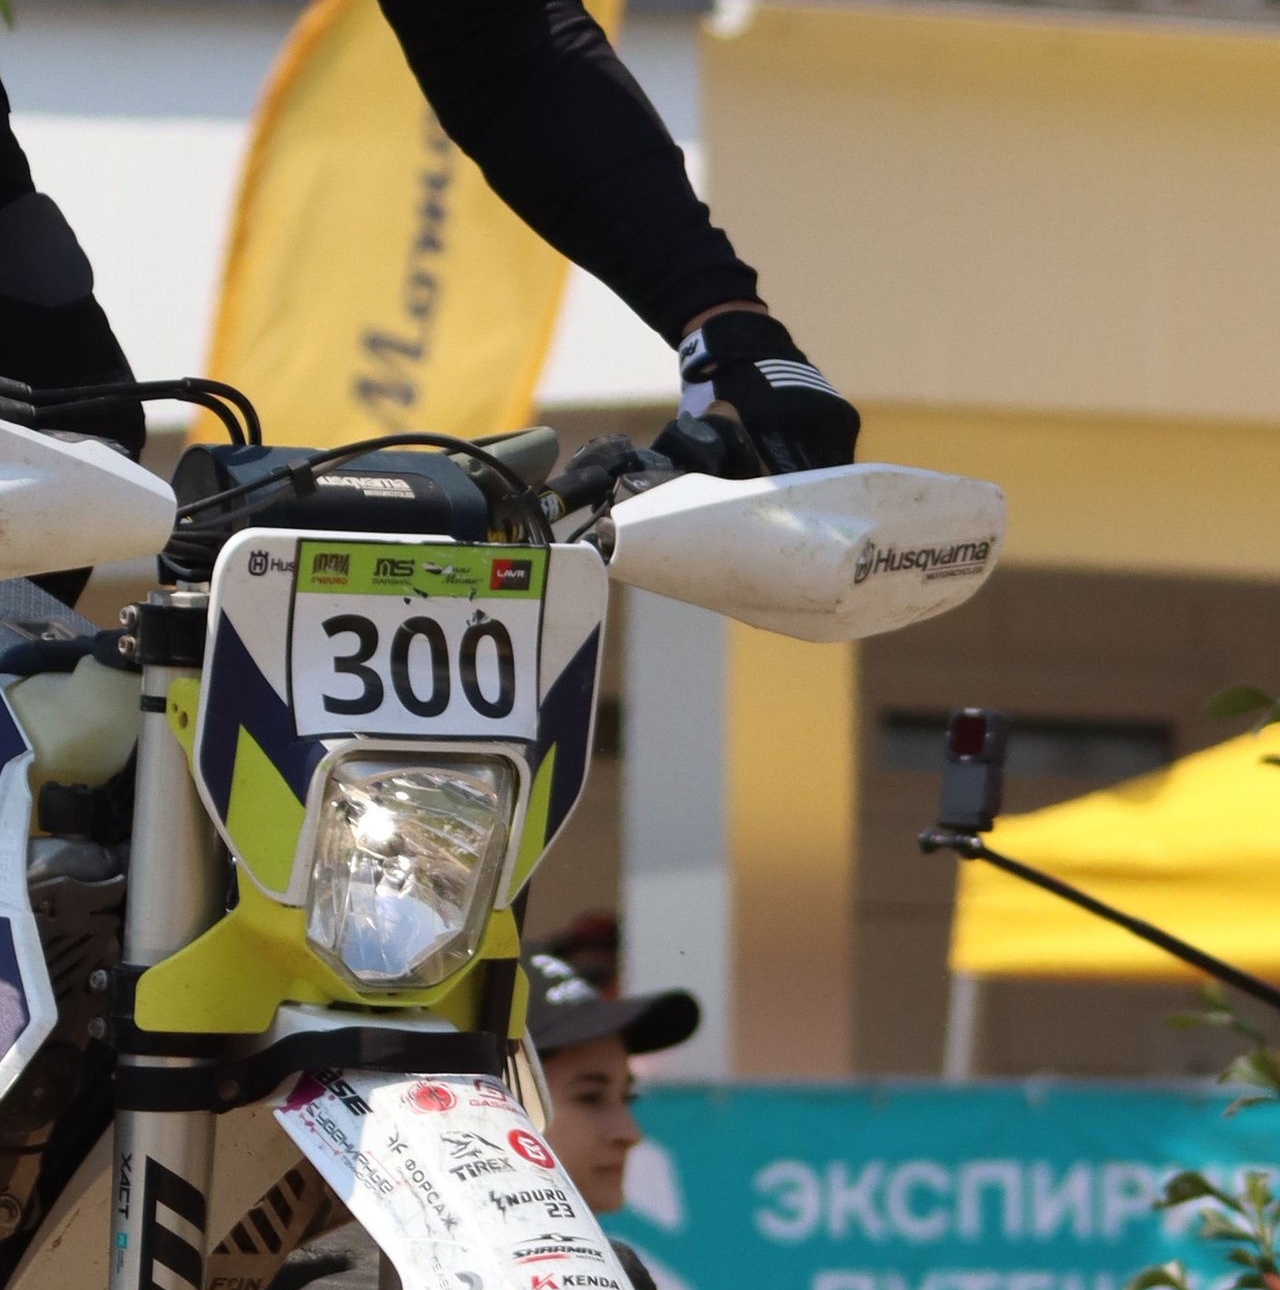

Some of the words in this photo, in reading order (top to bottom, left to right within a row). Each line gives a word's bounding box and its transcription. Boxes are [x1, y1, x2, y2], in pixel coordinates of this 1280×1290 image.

[495, 568, 526, 580] LAVR
[320, 613, 516, 720] 300
[404, 1159, 458, 1233] ФОРСАЖ
[547, 1204, 576, 1219] 23
[562, 1274, 621, 1290] KENDA
